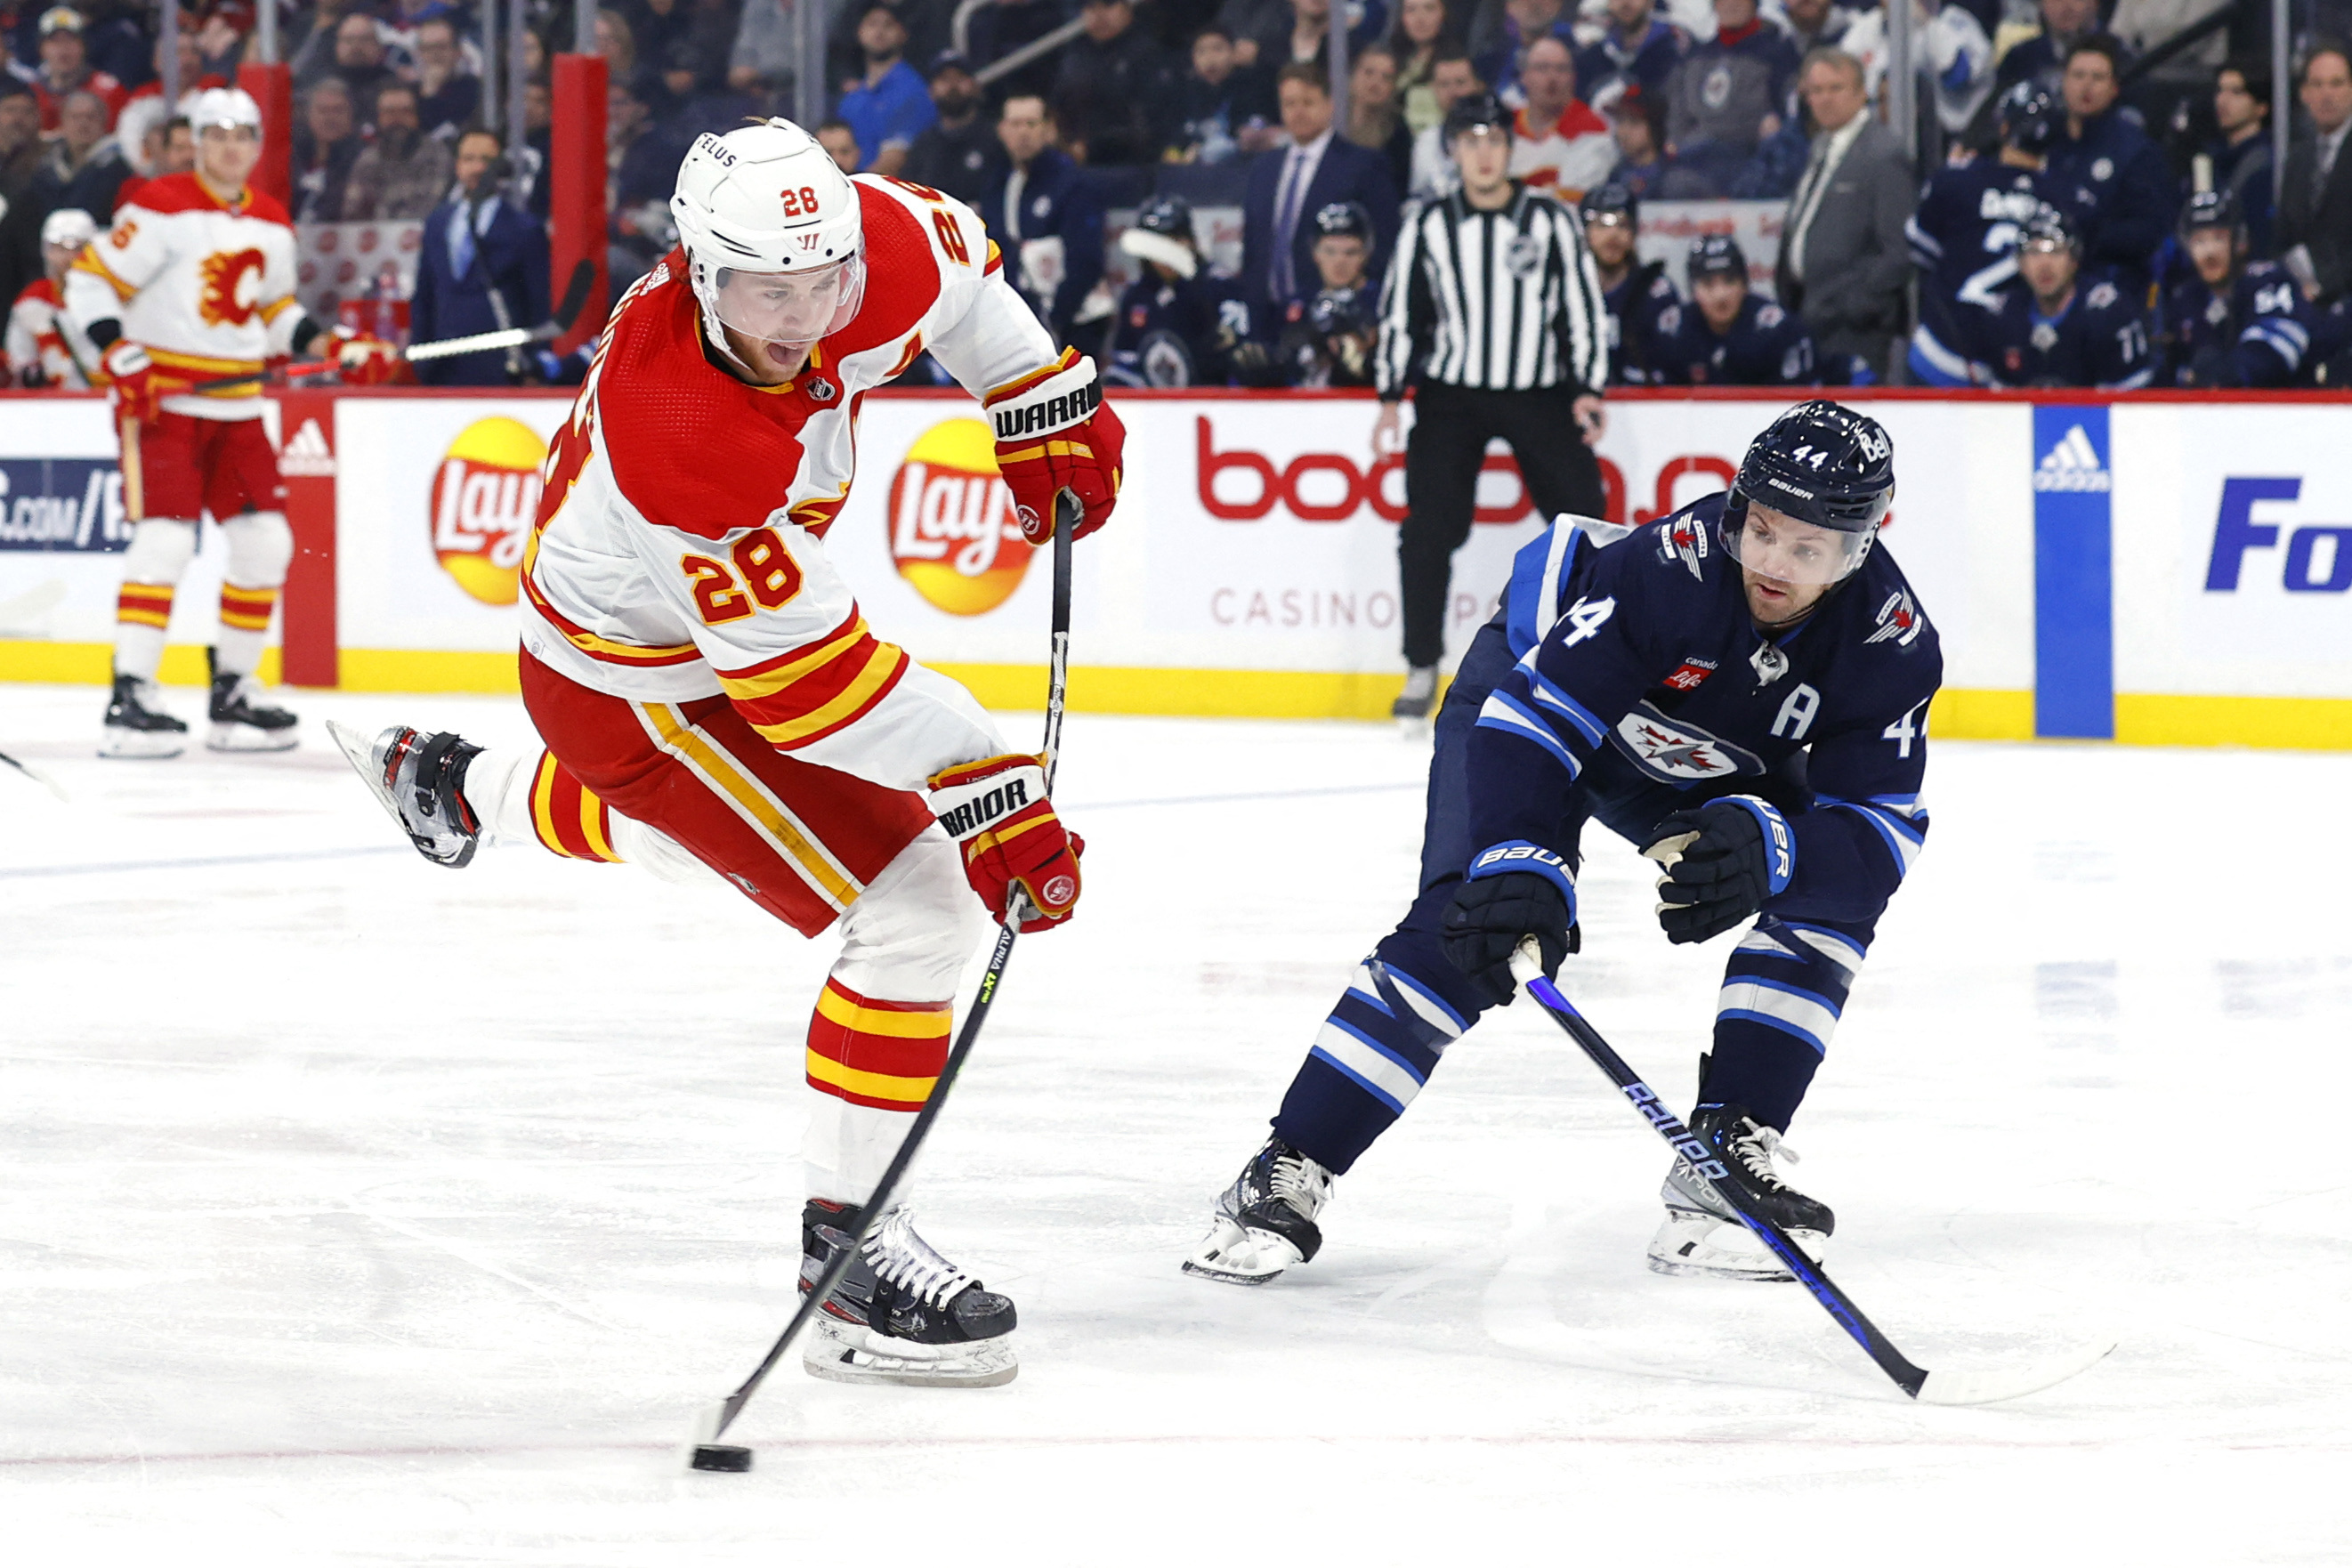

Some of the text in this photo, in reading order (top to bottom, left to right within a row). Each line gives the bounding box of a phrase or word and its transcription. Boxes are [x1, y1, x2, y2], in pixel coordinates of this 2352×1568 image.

[780, 185, 820, 218] 28
[1792, 444, 1829, 470] 44
[1858, 427, 1891, 464] Bell
[679, 526, 804, 626] 28
[1208, 586, 1398, 630] CASINO
[1669, 669, 1702, 689] life
[1769, 682, 1821, 740] A
[1879, 695, 1930, 760] 4
[990, 929, 1012, 970] ALPHA
